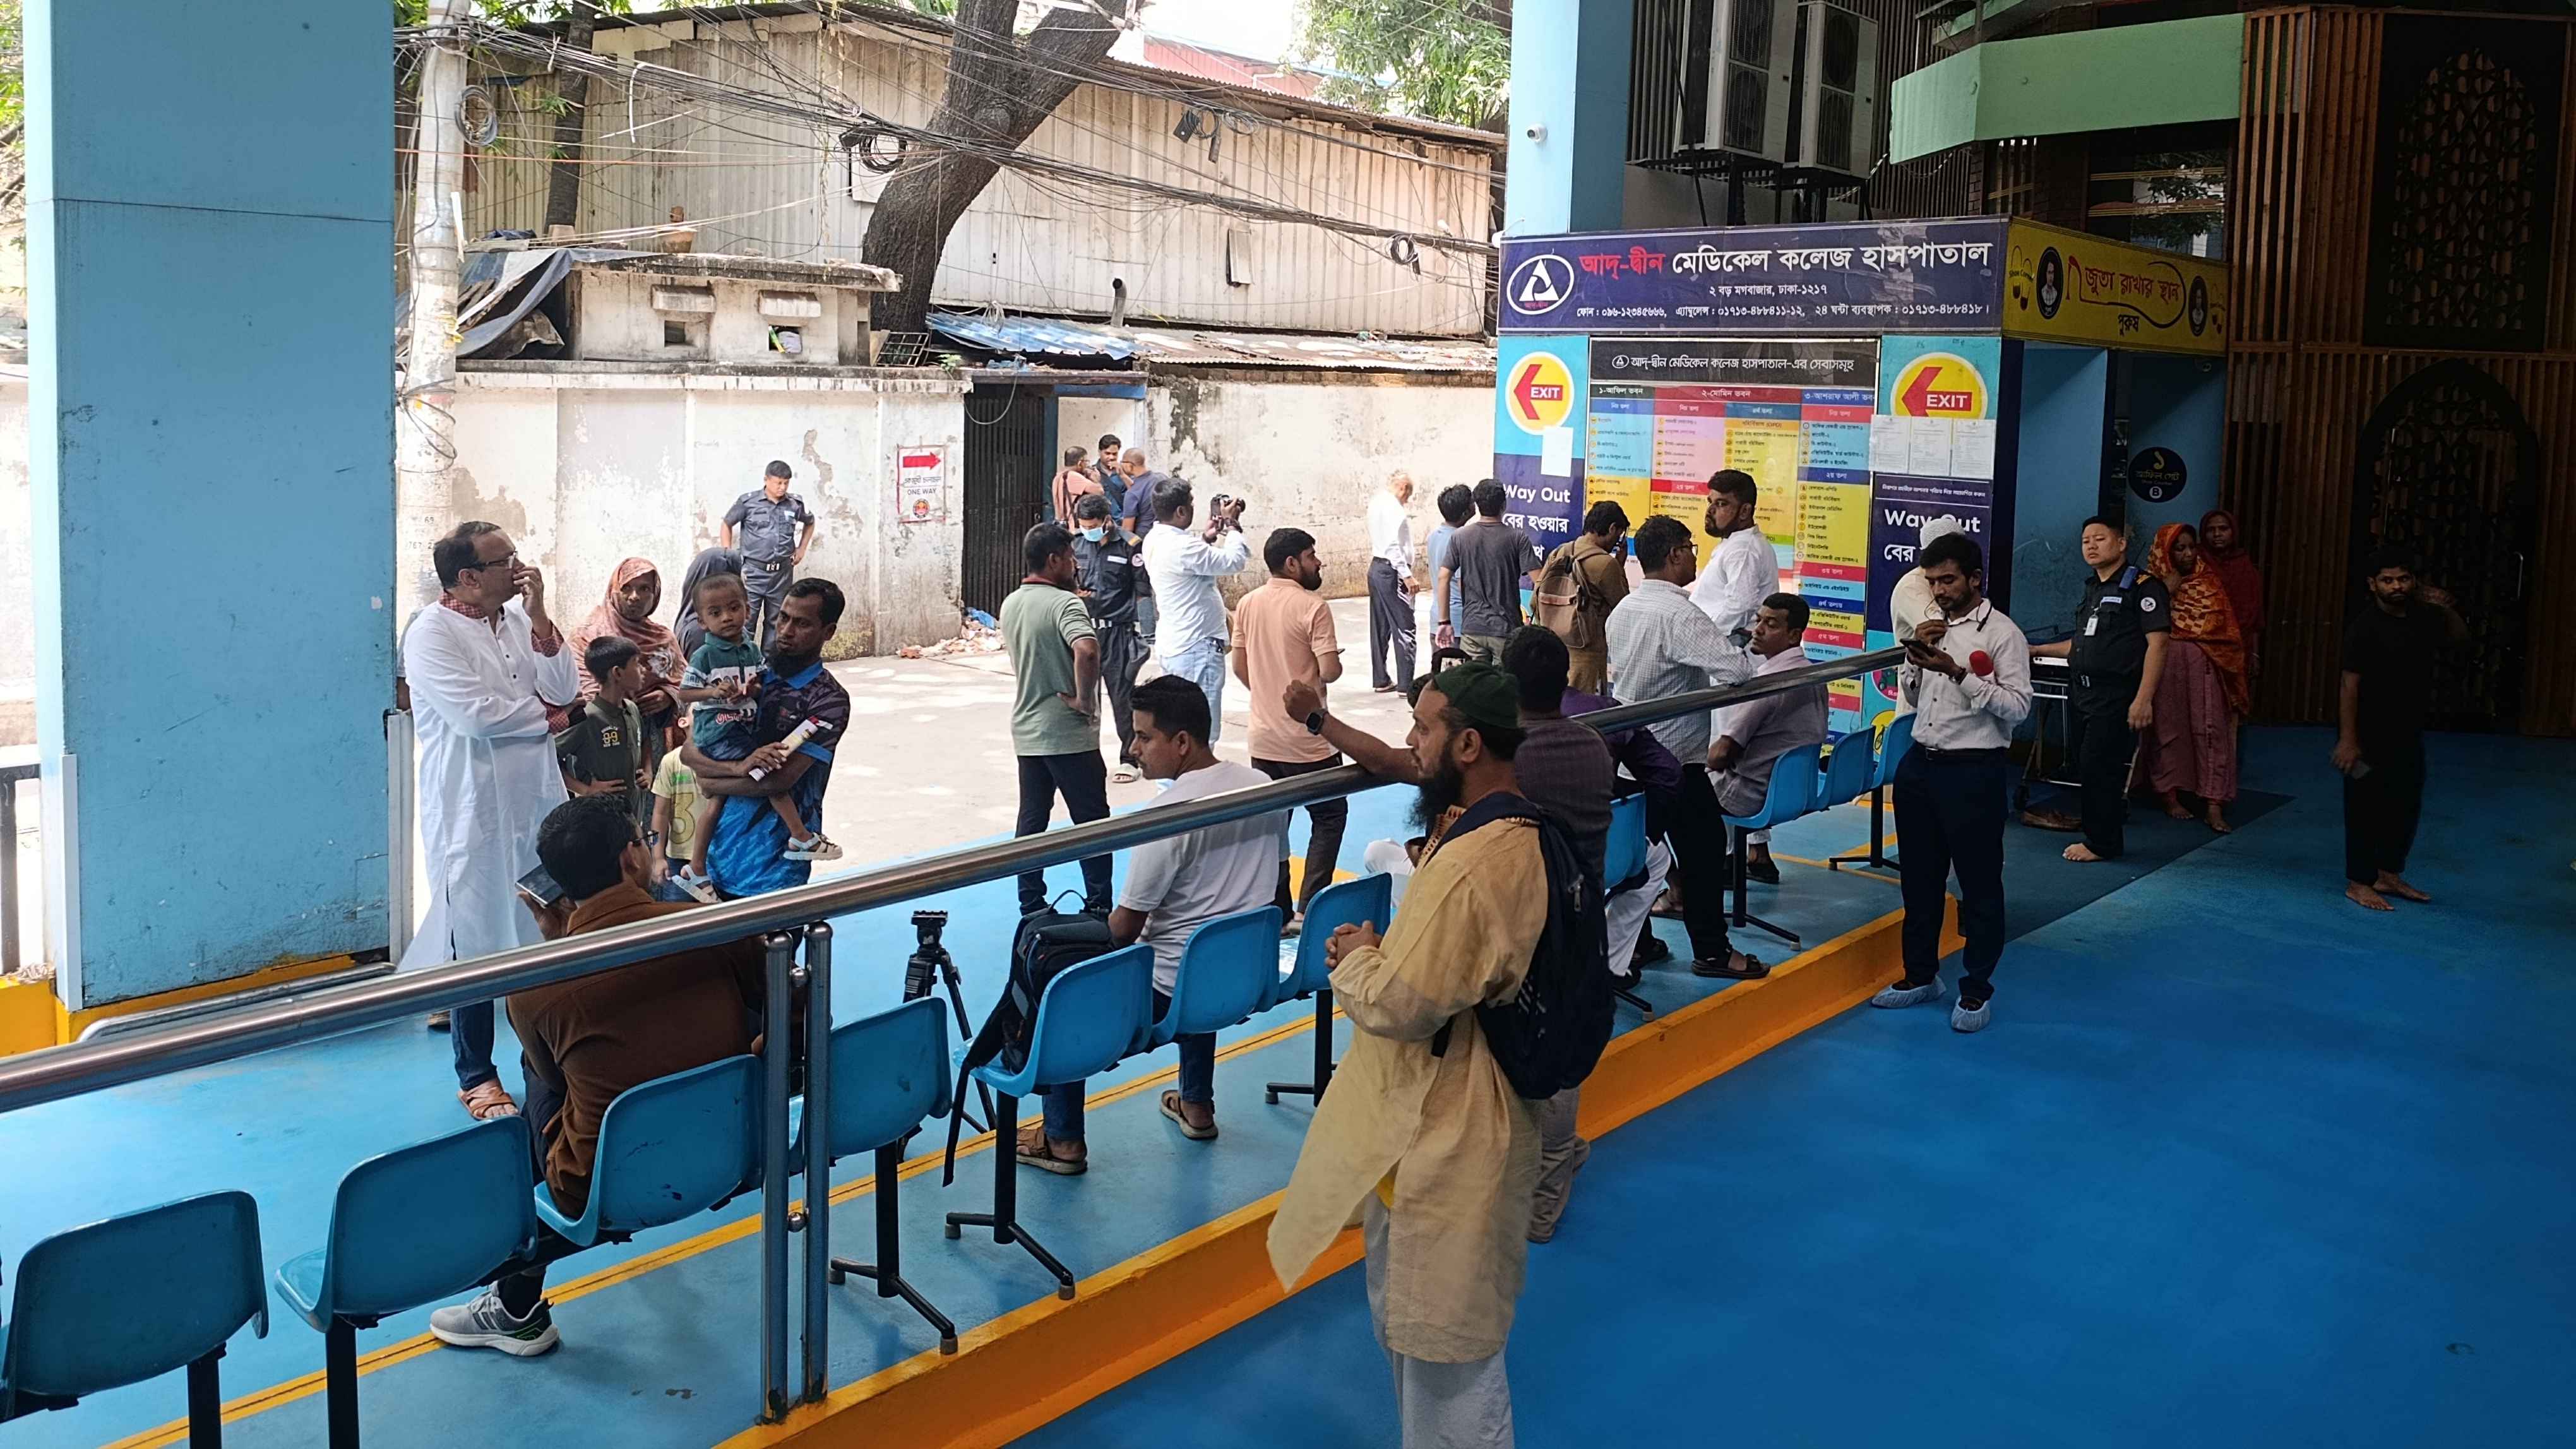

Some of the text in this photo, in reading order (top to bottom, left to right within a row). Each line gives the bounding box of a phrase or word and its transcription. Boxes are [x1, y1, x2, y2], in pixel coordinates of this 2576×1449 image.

[1673, 245, 1772, 273] মেডিকেল
[1777, 247, 1854, 271] কলেজ
[1860, 241, 1993, 272] হাসপাতাল
[1709, 287, 1716, 295] ২
[1719, 285, 1731, 295] বড়
[1778, 284, 1828, 295] ঢাকা-১২১৭
[2085, 267, 2181, 304] জুতা রাখার স্থান
[1577, 307, 1594, 317] ফোন
[1815, 305, 1828, 316] ২৪
[2118, 314, 2140, 336] পুরুষ
[1669, 354, 1708, 368] মেডিকেল
[1711, 357, 1739, 368] কলেজ
[1743, 355, 1808, 370] হাসপাতাল-এর
[1810, 357, 1854, 372] সেবাসমূহ
[1530, 386, 1560, 399] EXIT
[1926, 394, 1968, 408] EXIT
[1503, 483, 1571, 503] Way Out
[2152, 487, 2160, 496] B
[1502, 512, 1570, 533] বের হওয়ার
[1885, 509, 1931, 529] Way
[1884, 543, 1916, 563] বের
[670, 792, 695, 845] 3
